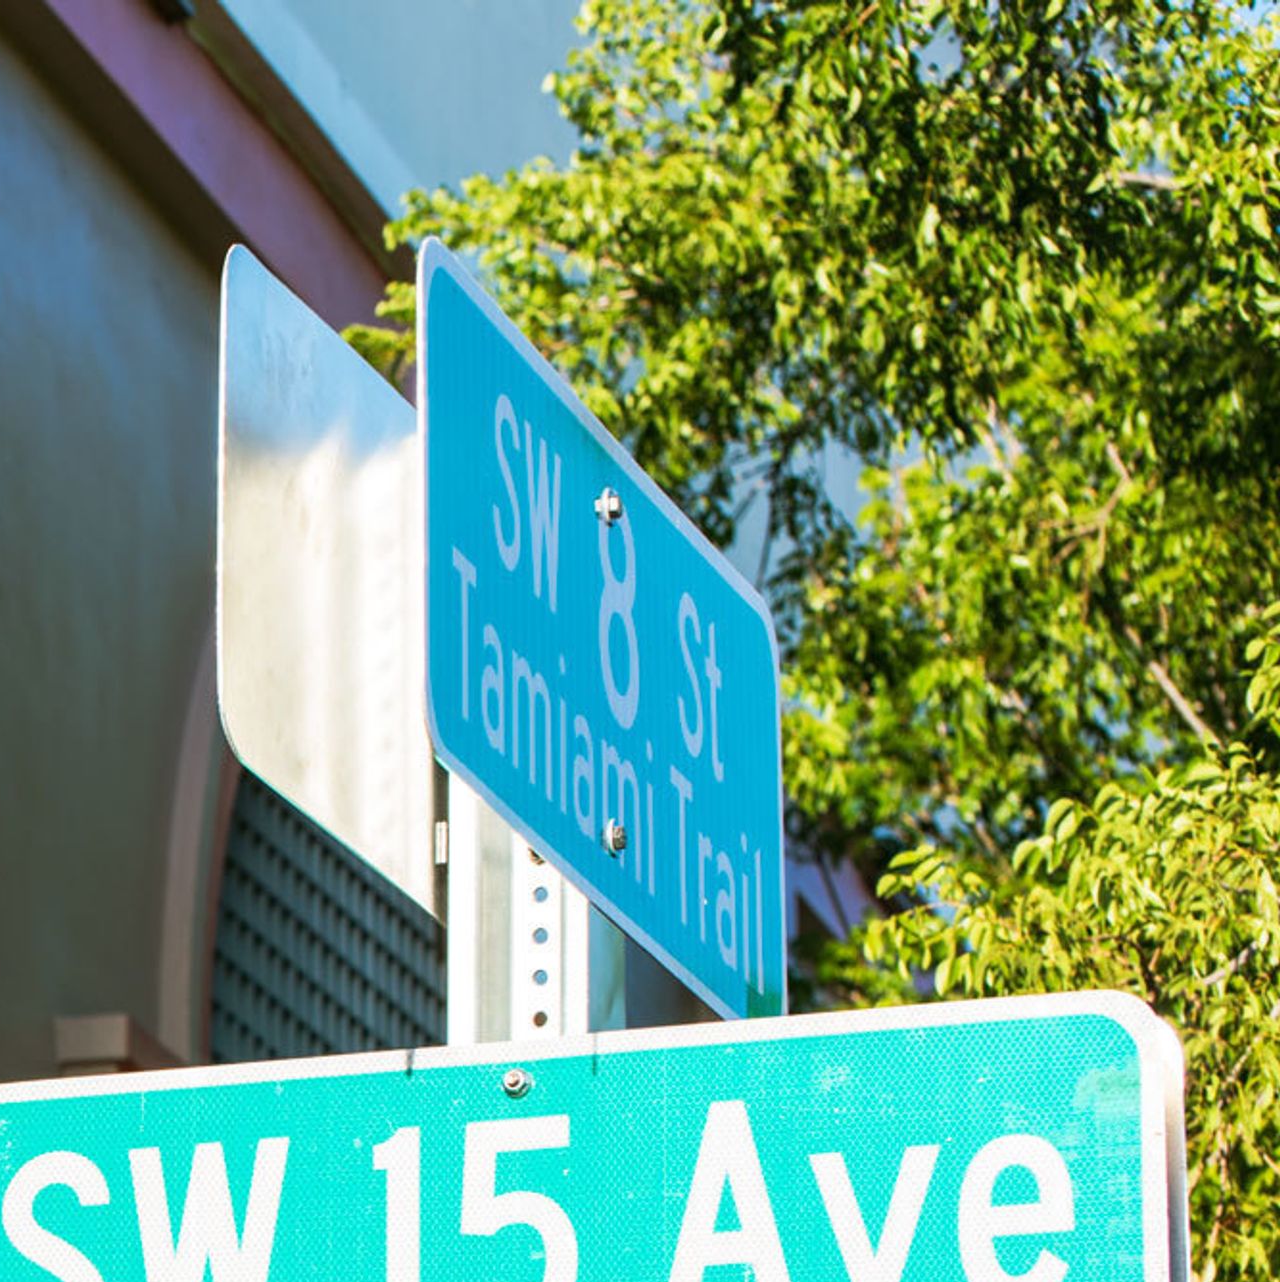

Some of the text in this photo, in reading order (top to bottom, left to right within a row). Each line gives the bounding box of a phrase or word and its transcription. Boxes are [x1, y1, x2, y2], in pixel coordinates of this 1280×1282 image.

[451, 546, 764, 996] Tamiami Trail
[493, 393, 725, 783] SW 8 St
